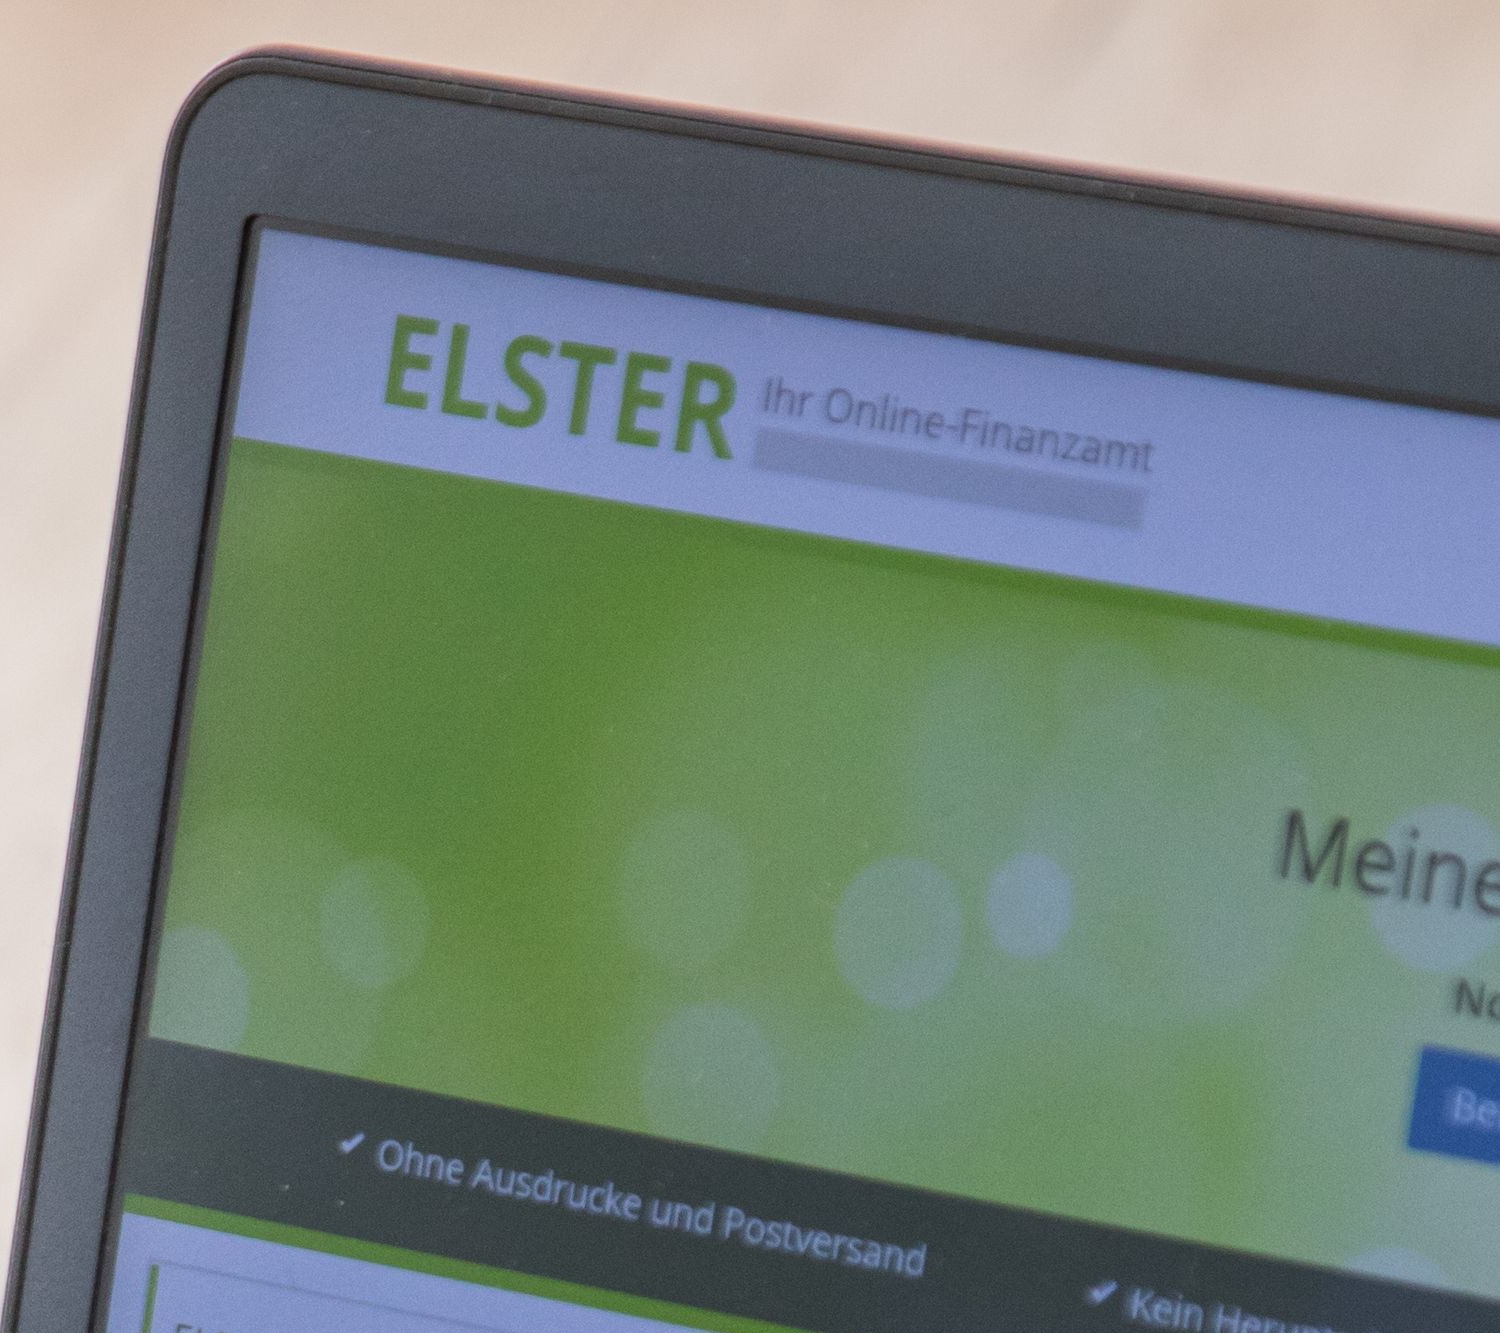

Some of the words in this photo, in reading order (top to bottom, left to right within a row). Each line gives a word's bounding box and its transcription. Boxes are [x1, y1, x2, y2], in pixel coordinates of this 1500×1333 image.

[383, 314, 737, 459] ELSTER
[762, 377, 812, 416] Ihr
[825, 387, 1154, 474] Online-Finanzamt
[376, 1138, 464, 1185] Ohne
[471, 1158, 642, 1221] Ausdrucke
[650, 1182, 713, 1234] und
[724, 1206, 926, 1277] Postversand
[1125, 1288, 1203, 1332] Kein
